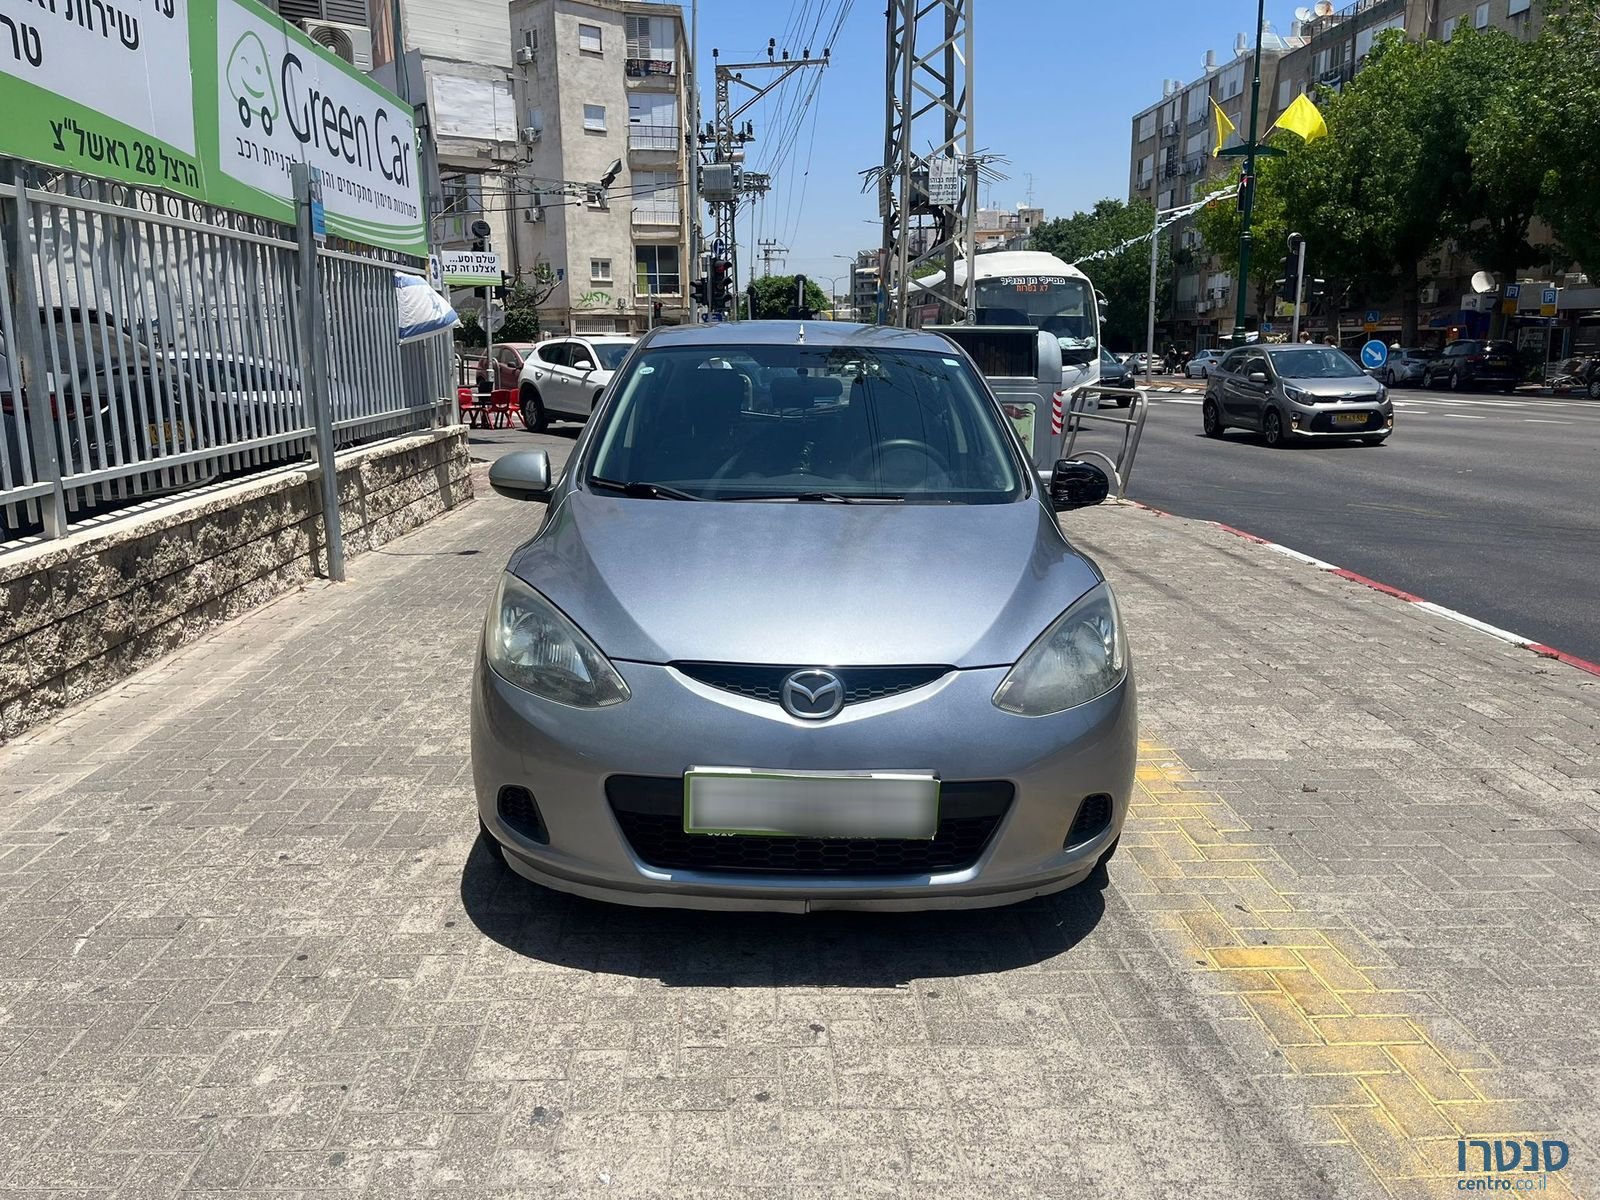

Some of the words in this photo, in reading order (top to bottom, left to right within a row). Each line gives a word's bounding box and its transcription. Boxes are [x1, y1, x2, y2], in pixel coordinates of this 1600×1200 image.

[281, 52, 373, 172] Green
[374, 107, 410, 189] Car
[132, 141, 157, 176] 28
[236, 136, 260, 162] רכב
[158, 147, 200, 189] הרצל
[337, 176, 373, 204] מתקדמים
[373, 190, 393, 210] מימון
[393, 198, 418, 219] פתרונות
[459, 264, 470, 273] זה
[472, 263, 496, 273] אצלנו
[476, 254, 496, 264] שלם
